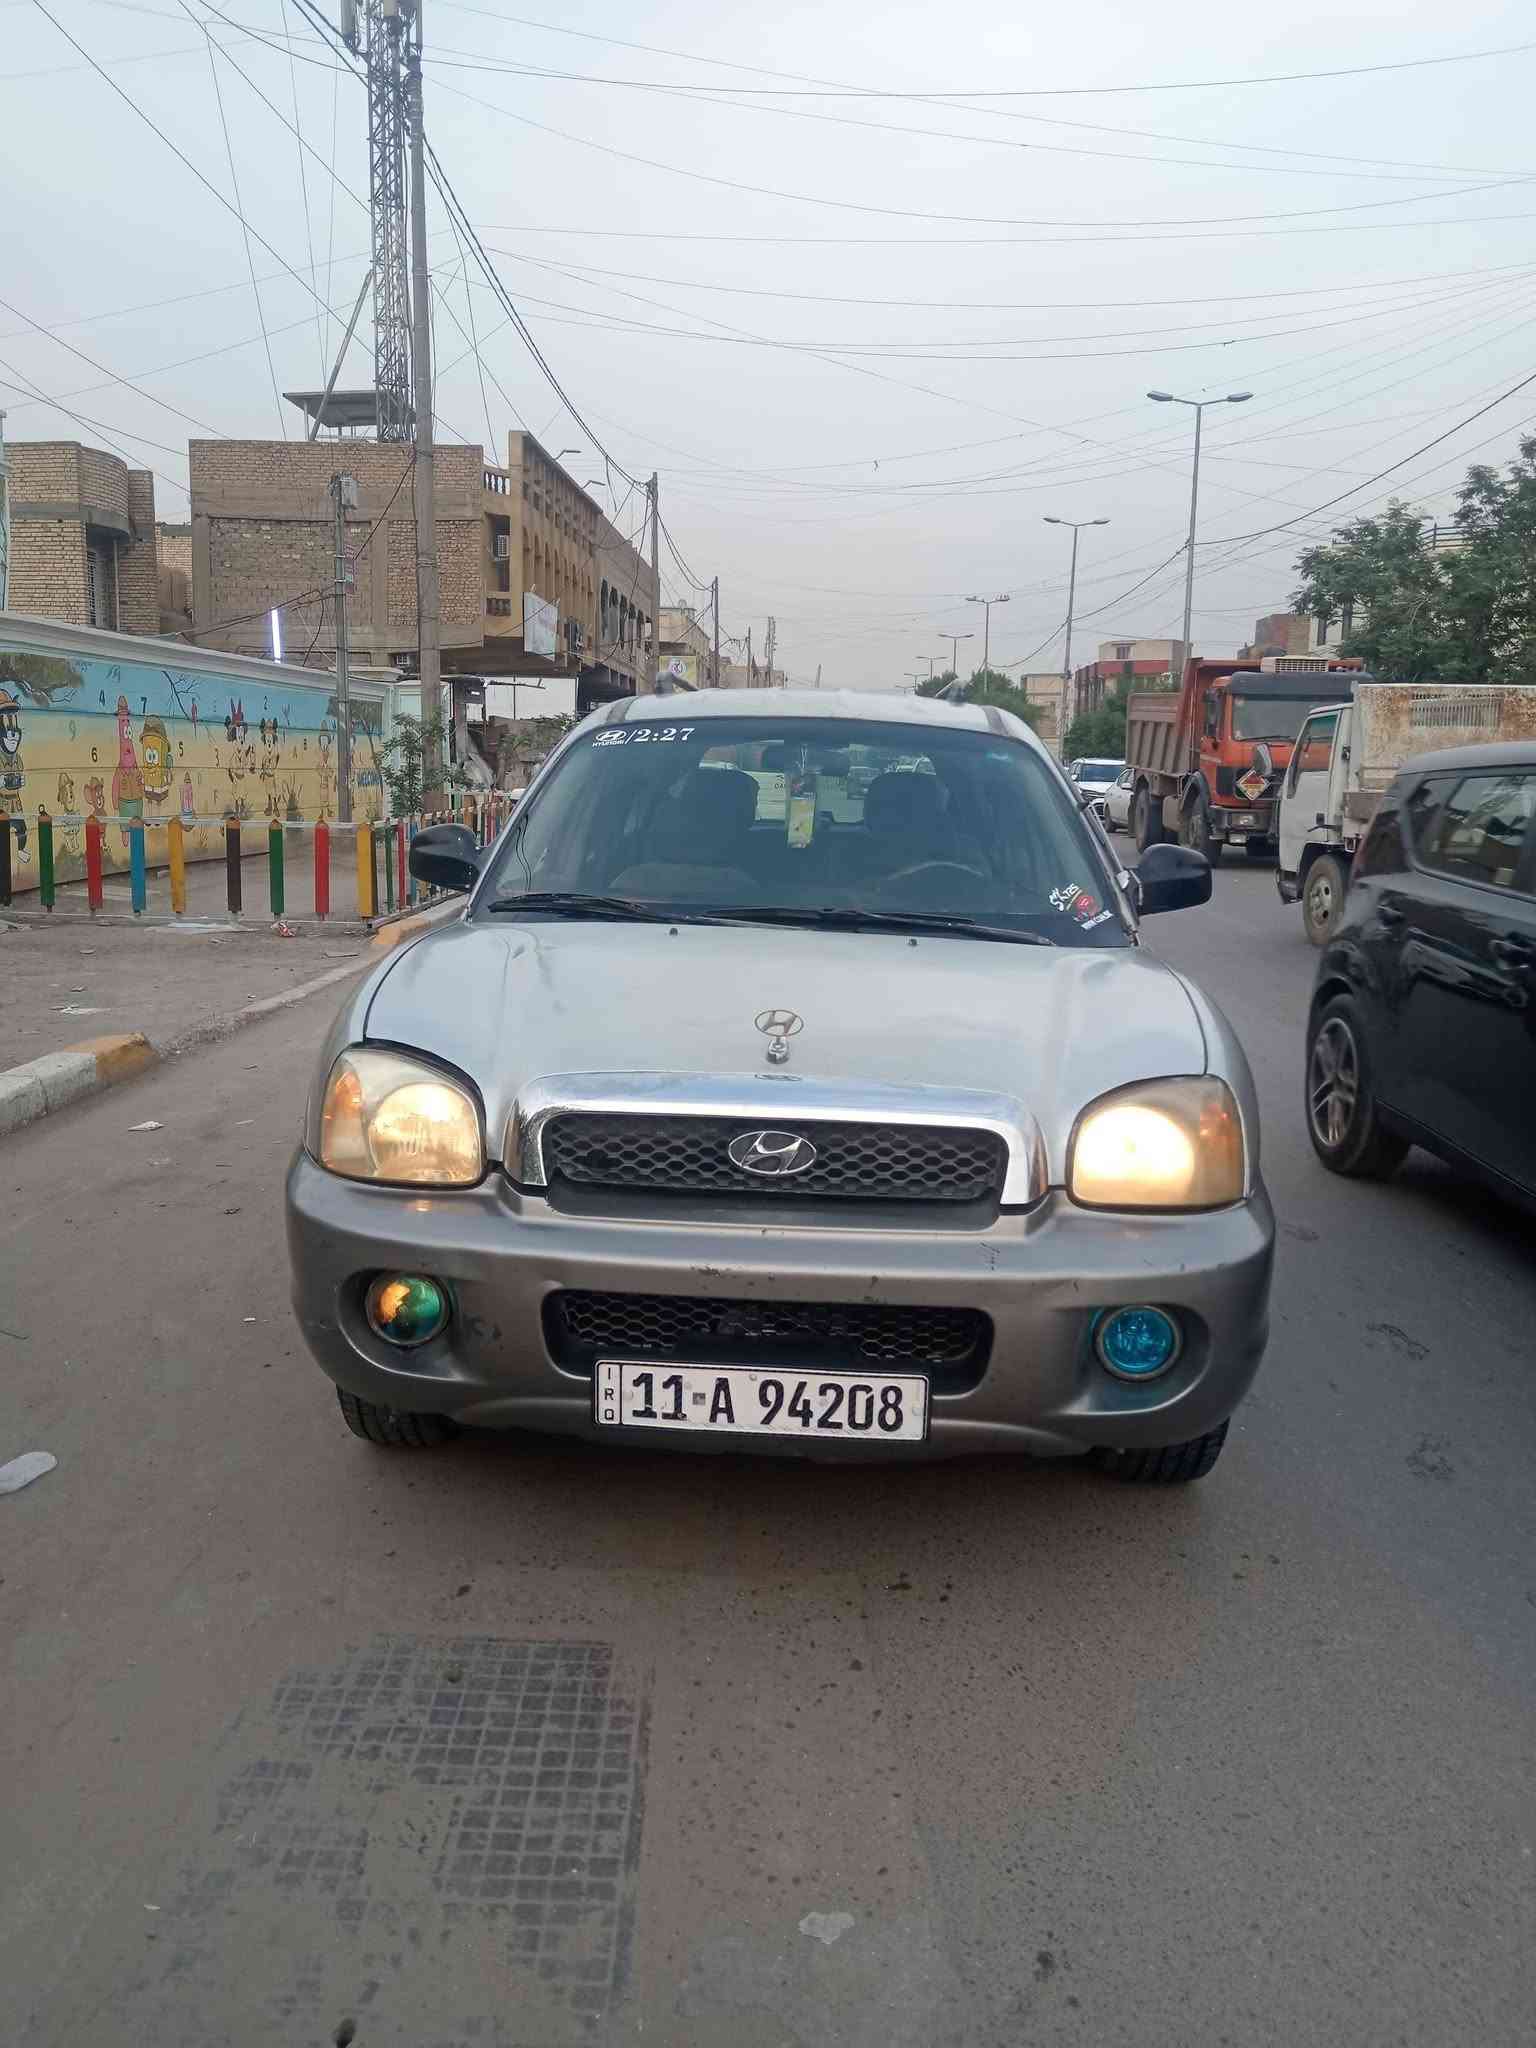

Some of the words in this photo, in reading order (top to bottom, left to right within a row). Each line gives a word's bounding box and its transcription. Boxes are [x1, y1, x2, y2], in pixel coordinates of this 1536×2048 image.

[140, 697, 147, 714] 7
[91, 747, 98, 762] 6
[631, 1371, 688, 1421] 11
[708, 1376, 736, 1425] A
[758, 1378, 905, 1433] 94208
